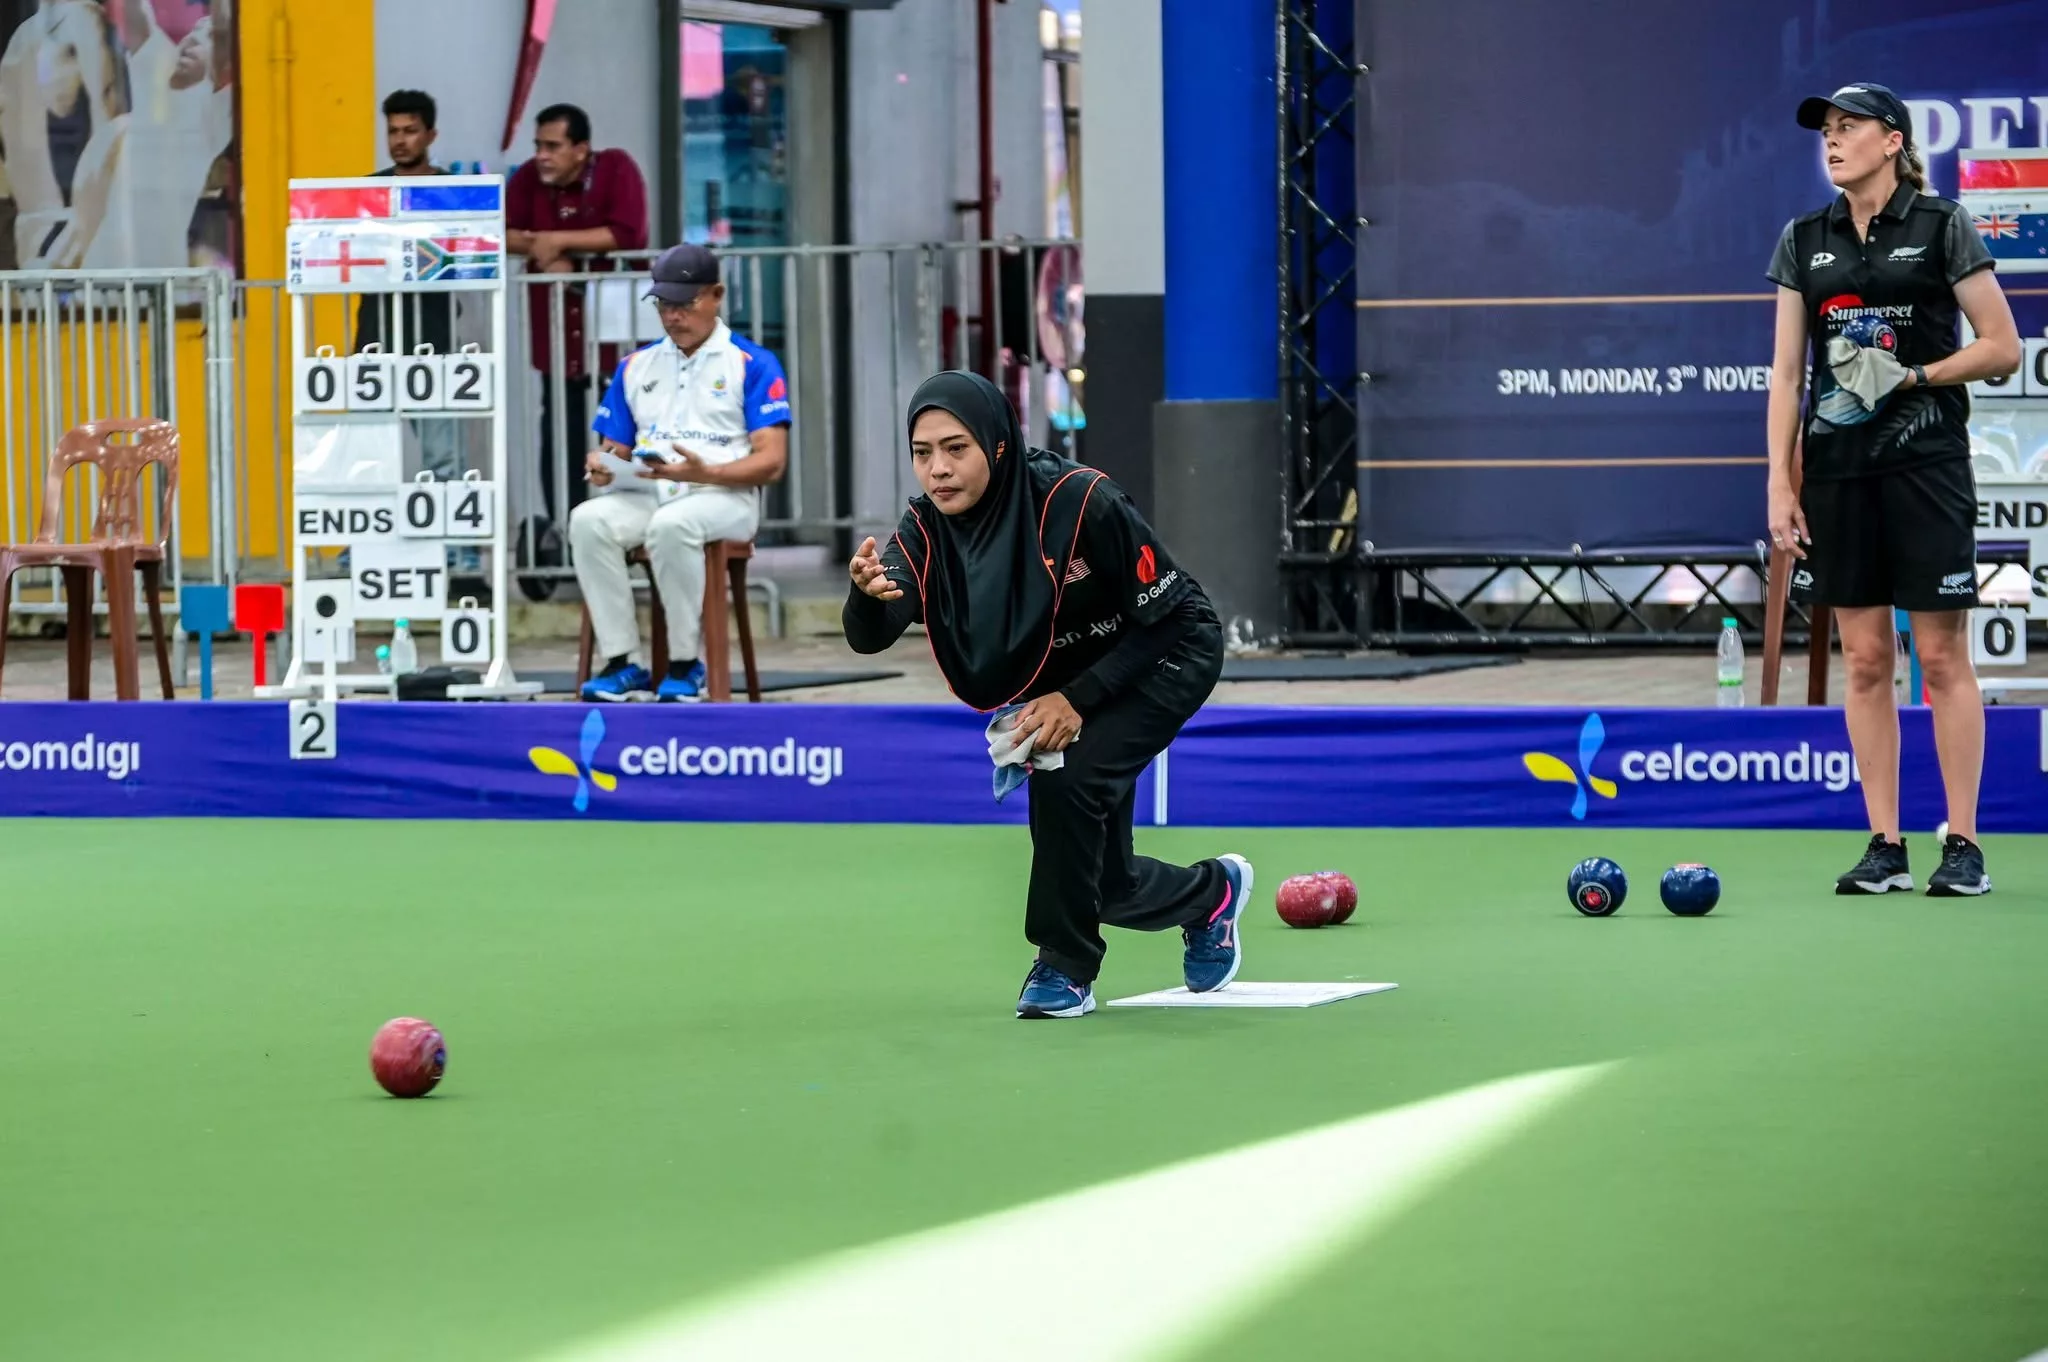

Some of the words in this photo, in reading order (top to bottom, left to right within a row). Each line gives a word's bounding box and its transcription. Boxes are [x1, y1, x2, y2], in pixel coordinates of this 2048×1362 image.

[402, 240, 413, 282] RSA
[1828, 304, 1913, 321] Summerset
[1498, 369, 1556, 398] 3PM,
[1560, 367, 1662, 397] MONDAY,
[1666, 364, 1698, 393] 3RD
[299, 508, 394, 535] ENDS
[358, 567, 441, 600] SET
[1149, 569, 1178, 598] Guthrie
[451, 617, 479, 653] 0
[1983, 616, 2015, 656] 0
[300, 711, 326, 752] 2
[0, 733, 140, 780] omdigi
[619, 737, 844, 785] celcomdigi
